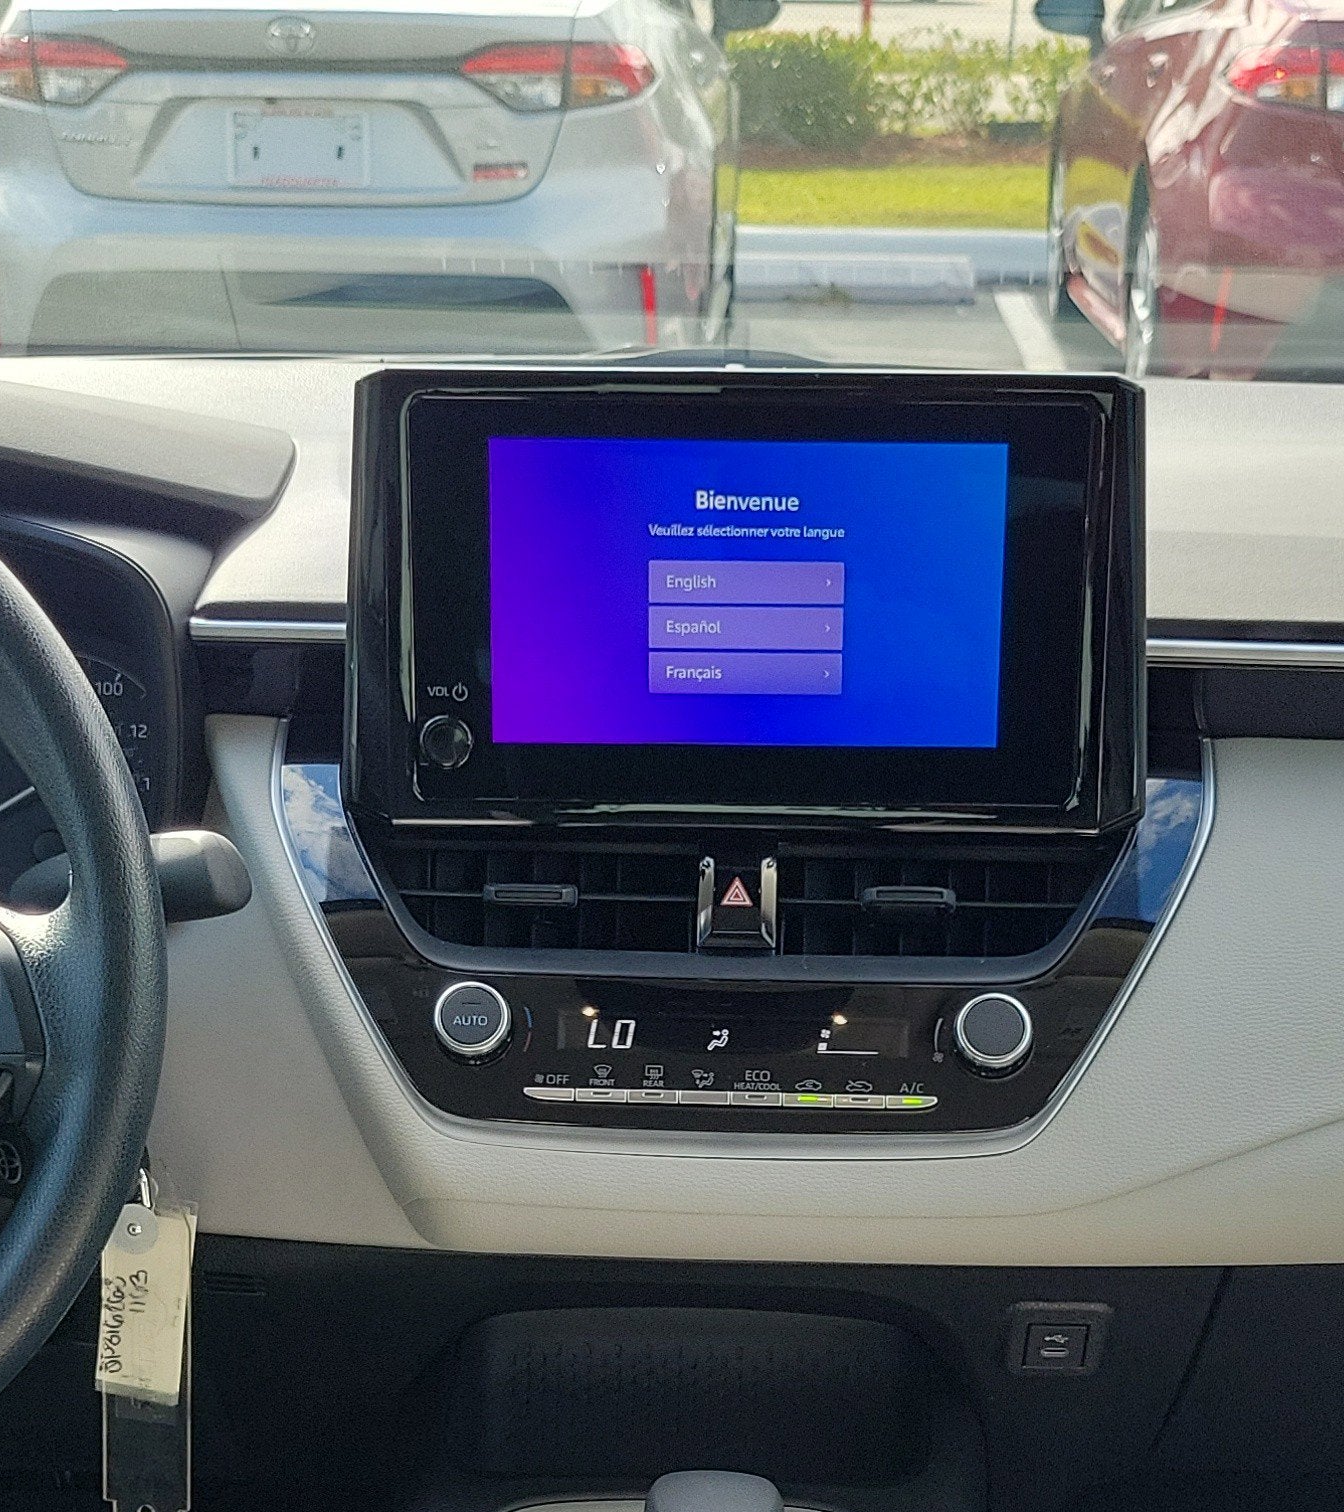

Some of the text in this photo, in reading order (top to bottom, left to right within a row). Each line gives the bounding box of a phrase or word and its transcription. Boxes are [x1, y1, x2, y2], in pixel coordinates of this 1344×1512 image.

[695, 490, 800, 511] Bienvenue
[648, 524, 845, 540] Veuillez sélectionner votre langue
[666, 575, 717, 592] English
[666, 620, 722, 636] Español
[666, 665, 722, 682] Français
[95, 682, 123, 696] 100
[427, 686, 450, 697] VOL
[453, 1015, 488, 1026] AUTO
[546, 1074, 570, 1085] OFF
[745, 1070, 771, 1082] ECO
[589, 1078, 616, 1087] FRONT
[642, 1080, 665, 1088] REAR
[734, 1082, 781, 1091] HEAT/COOL
[899, 1082, 924, 1094] A/C
